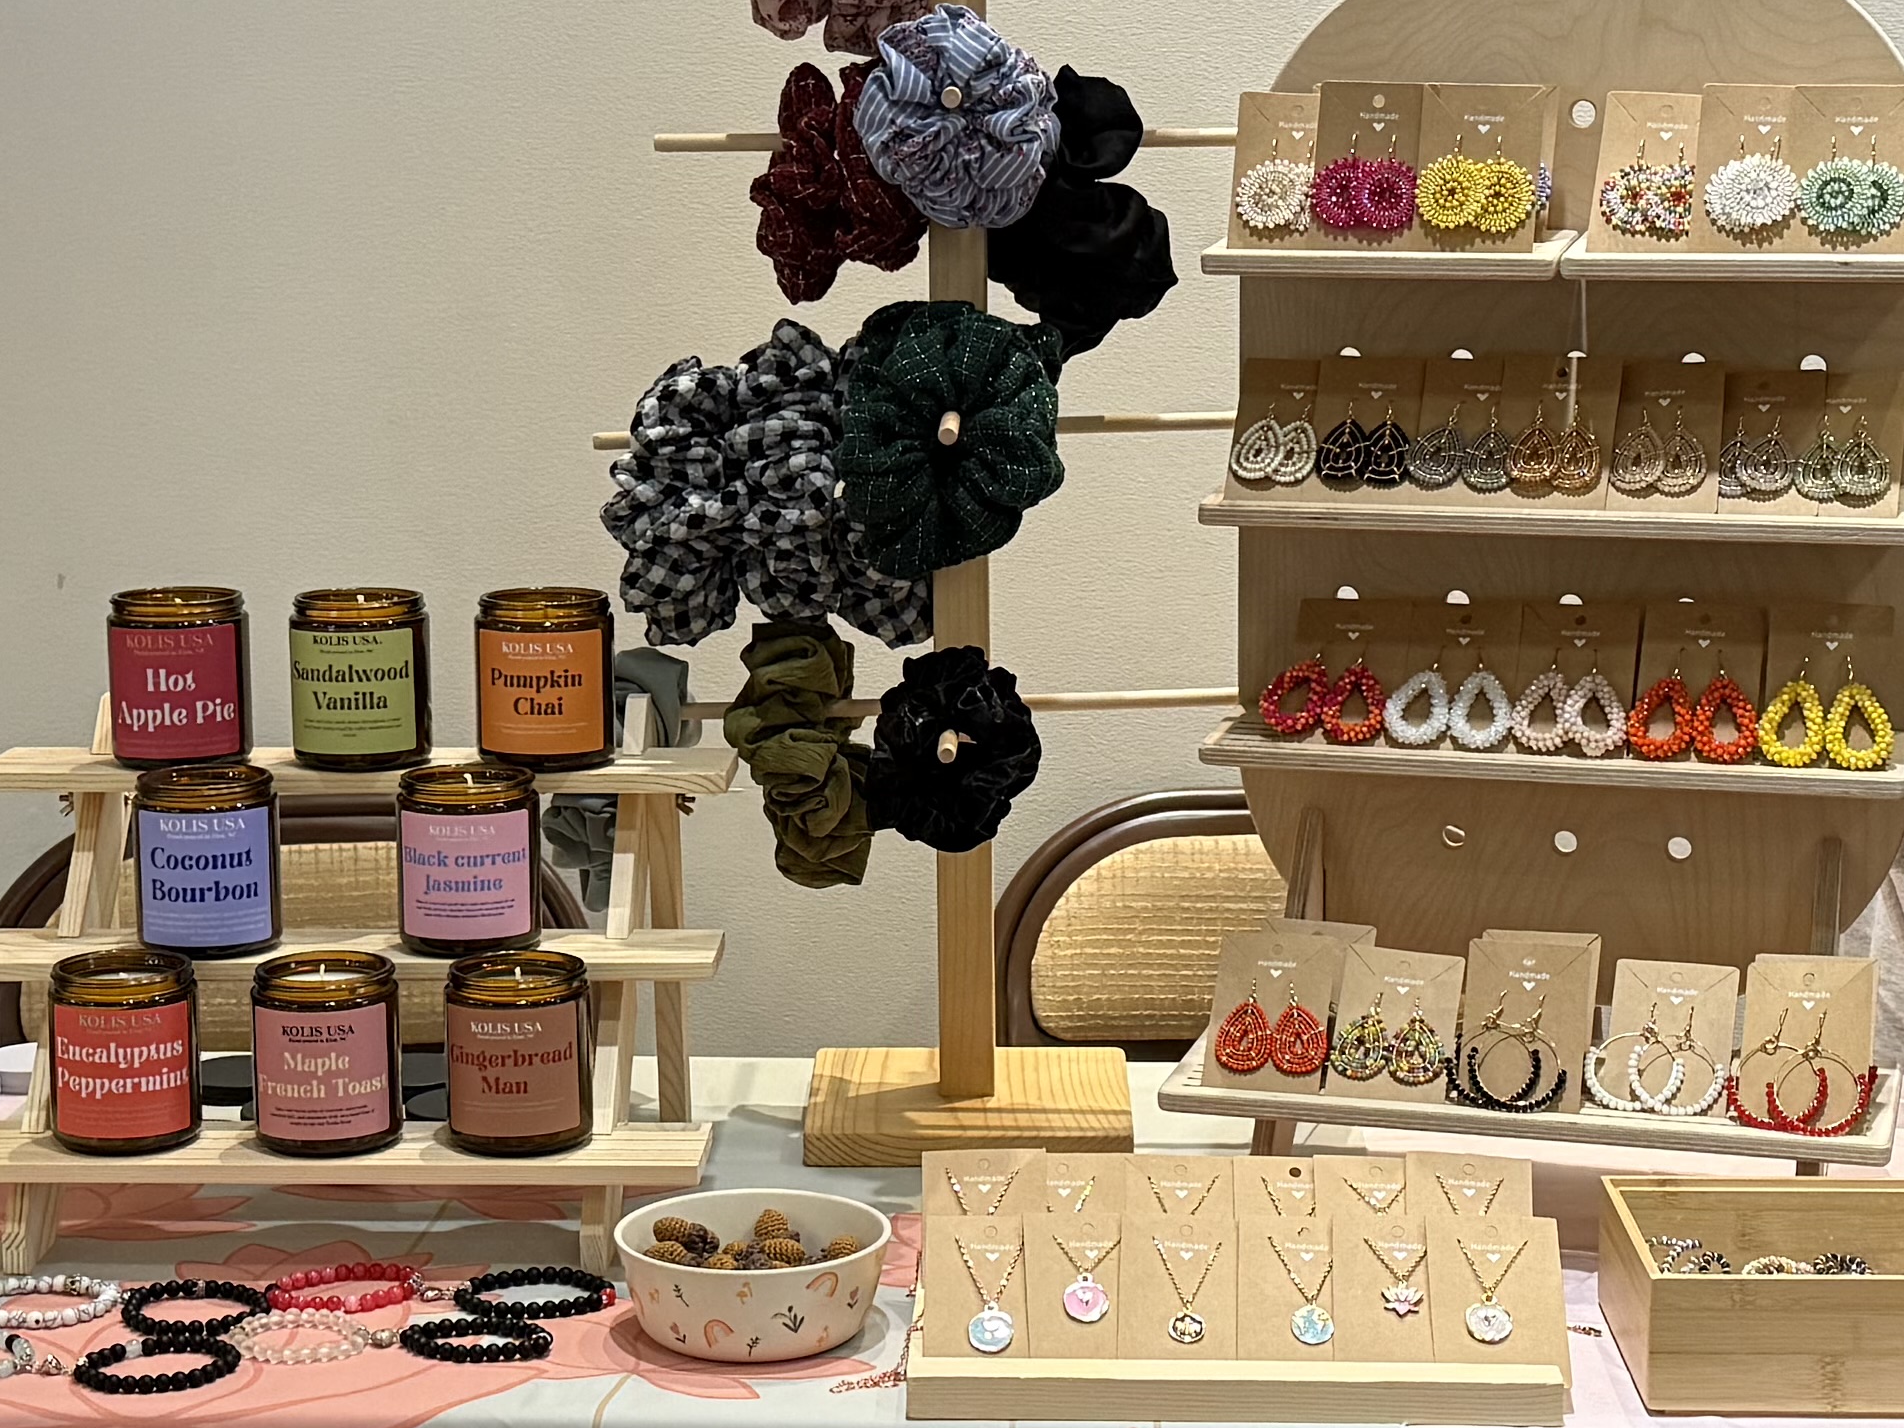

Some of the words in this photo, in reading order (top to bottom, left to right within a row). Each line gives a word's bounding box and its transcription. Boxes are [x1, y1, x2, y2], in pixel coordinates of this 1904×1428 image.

[126, 633, 175, 650] KOLIS
[179, 632, 215, 649] USA
[311, 634, 349, 647] KOLIS
[501, 641, 543, 655] KOLIS
[545, 641, 575, 655] USA
[145, 667, 197, 693] Hot
[293, 659, 410, 683] Sandalwood
[490, 666, 584, 694] Pumpkin
[311, 690, 389, 711] Vanilla
[512, 695, 565, 717] Chai
[118, 700, 188, 733] Apple
[195, 697, 235, 725] Pie
[159, 817, 209, 833] KOLIS
[212, 816, 246, 832] USA
[428, 824, 467, 838] KOLIS
[469, 824, 496, 837] USA
[150, 845, 253, 871] Coconut
[404, 845, 450, 868] Black
[151, 877, 259, 903] Bourbon
[423, 873, 504, 895] Jasmine
[78, 1013, 127, 1029] KOLIS
[130, 1012, 163, 1028] USA
[281, 1024, 324, 1038] KOLIS
[326, 1023, 356, 1037] USA
[469, 1020, 511, 1034] KOLIS
[513, 1020, 543, 1034] USA
[56, 1035, 184, 1069] Eucalyptus
[450, 1040, 574, 1072] Gingerbread
[283, 1050, 351, 1077] Maple
[57, 1065, 190, 1100] Peppermint
[258, 1072, 327, 1100] French
[330, 1070, 388, 1097] Toast
[480, 1075, 529, 1095] Man
